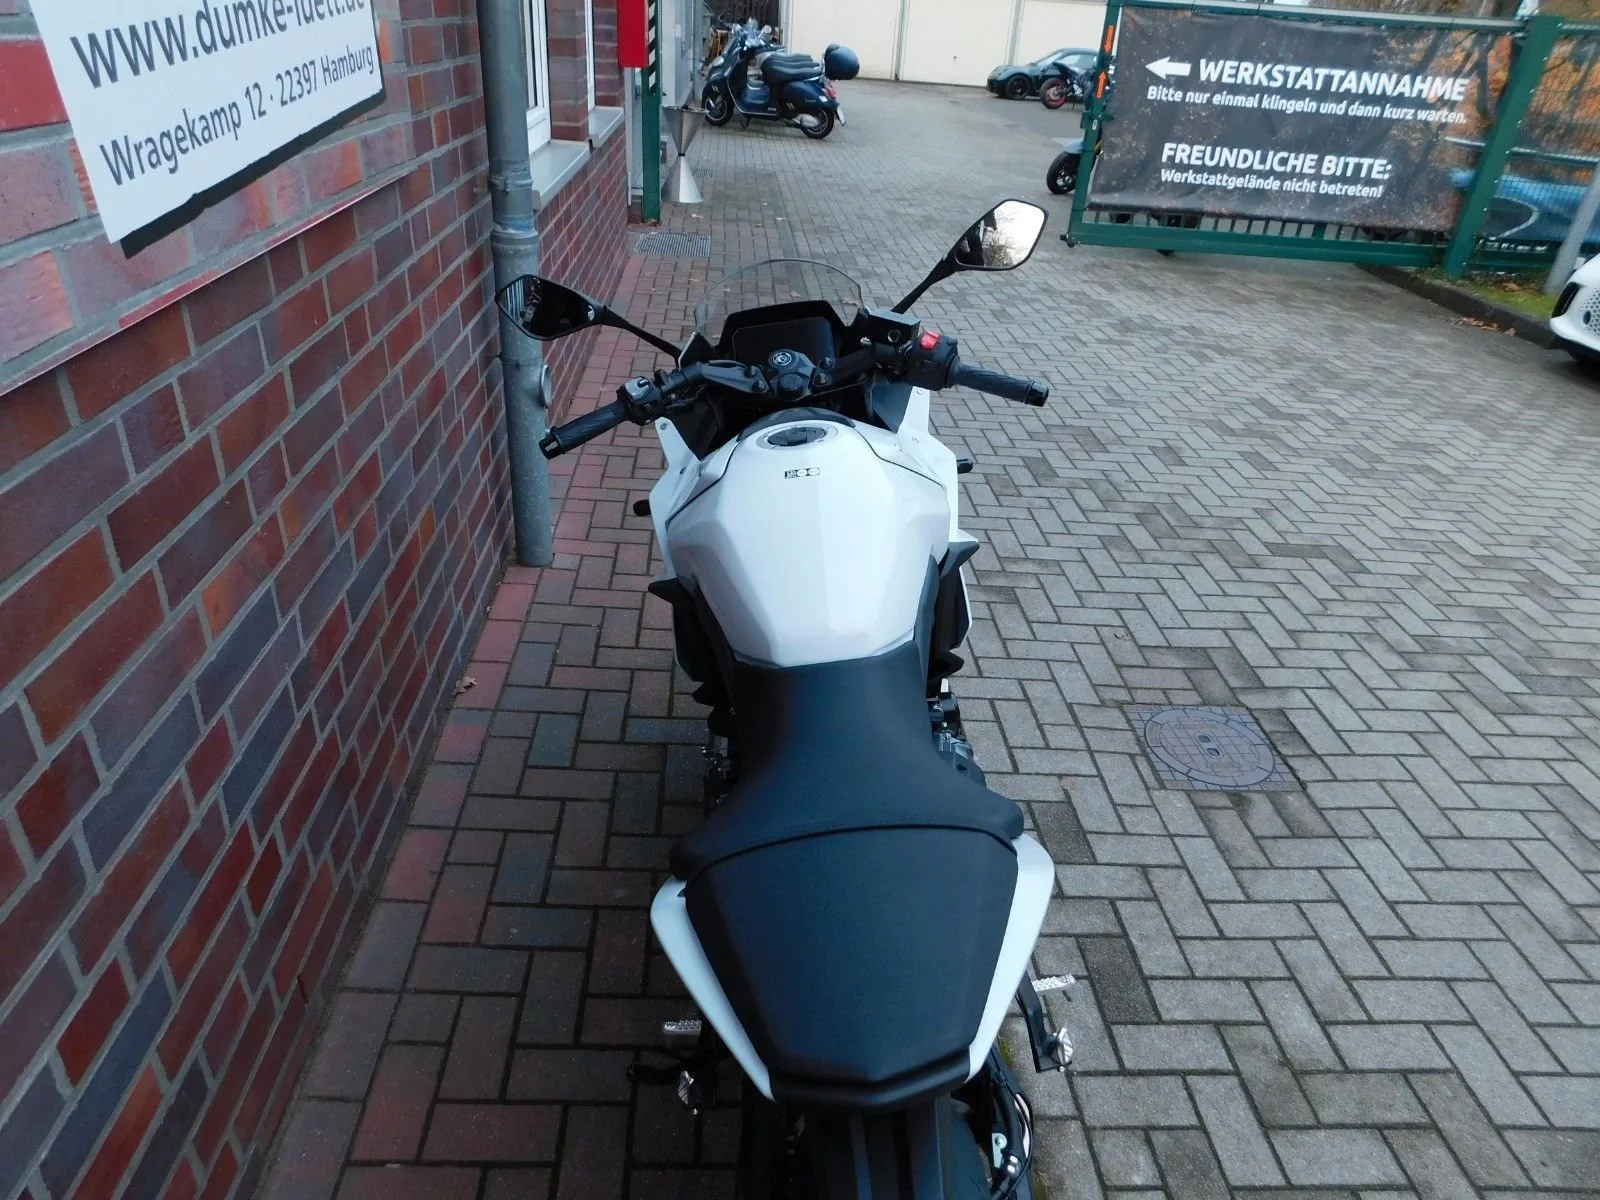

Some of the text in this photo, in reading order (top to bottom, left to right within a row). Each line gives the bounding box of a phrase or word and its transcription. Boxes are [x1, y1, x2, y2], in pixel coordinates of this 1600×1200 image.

[1199, 58, 1469, 101] WERKSTATTANNAHME
[100, 100, 242, 187] Wragekamp
[244, 82, 267, 121] 12
[275, 60, 319, 108] 22397
[321, 44, 374, 87] Hamburg
[1147, 84, 1467, 124] Bitte nur einmal klingeln und dann kurz warten.
[1161, 142, 1393, 180] FREUNDLICHE BITTE:
[1160, 168, 1384, 198] Werkstattgelände nicht betreten!
